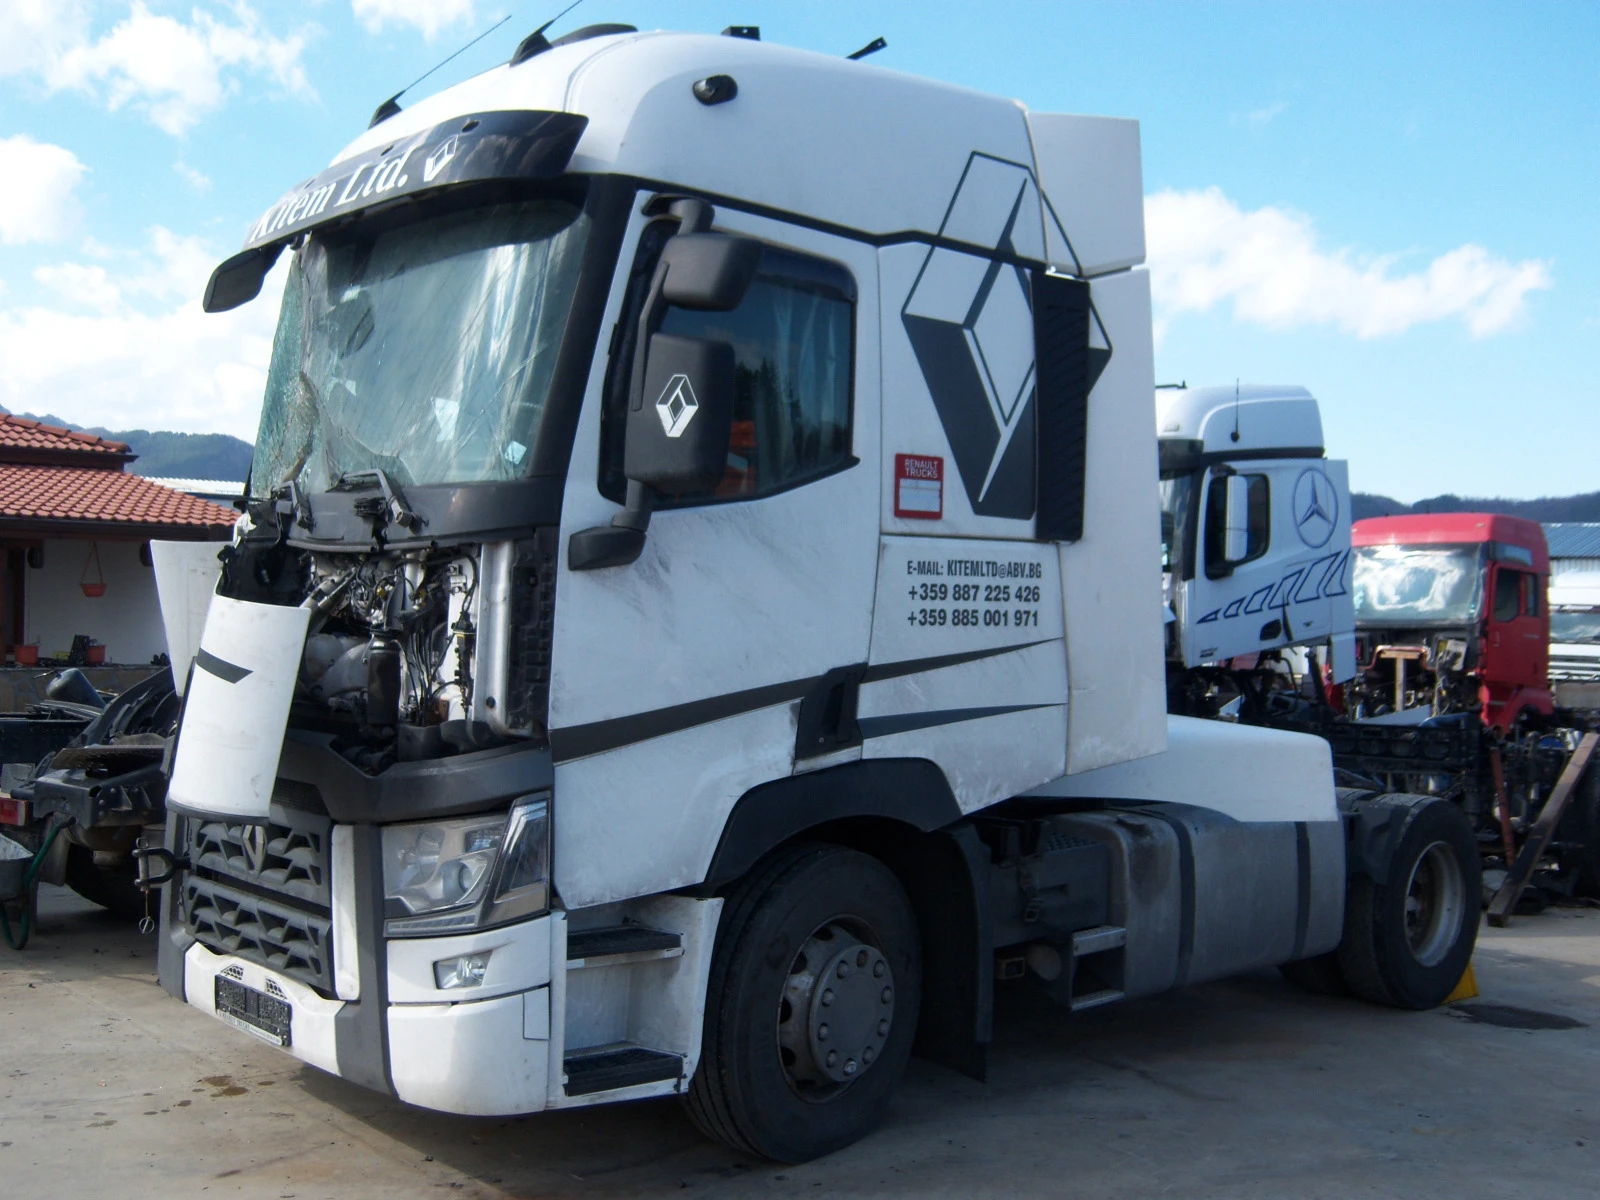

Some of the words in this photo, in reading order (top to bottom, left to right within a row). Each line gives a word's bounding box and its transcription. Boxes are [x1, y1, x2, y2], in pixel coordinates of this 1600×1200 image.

[334, 145, 416, 207] Ltd.
[904, 458, 938, 470] RENAULT
[905, 467, 938, 479] TRUCKS
[907, 560, 944, 576] E-MAIL:
[947, 559, 1042, 578] KITEMLTD@ABV.BG
[908, 583, 948, 601] +359
[952, 584, 980, 601] 887
[984, 585, 1010, 602] 225
[1014, 586, 1040, 603] 426
[907, 608, 947, 626] +359
[951, 609, 979, 626] 885
[983, 609, 1009, 627] 001
[1014, 609, 1039, 627] 971
